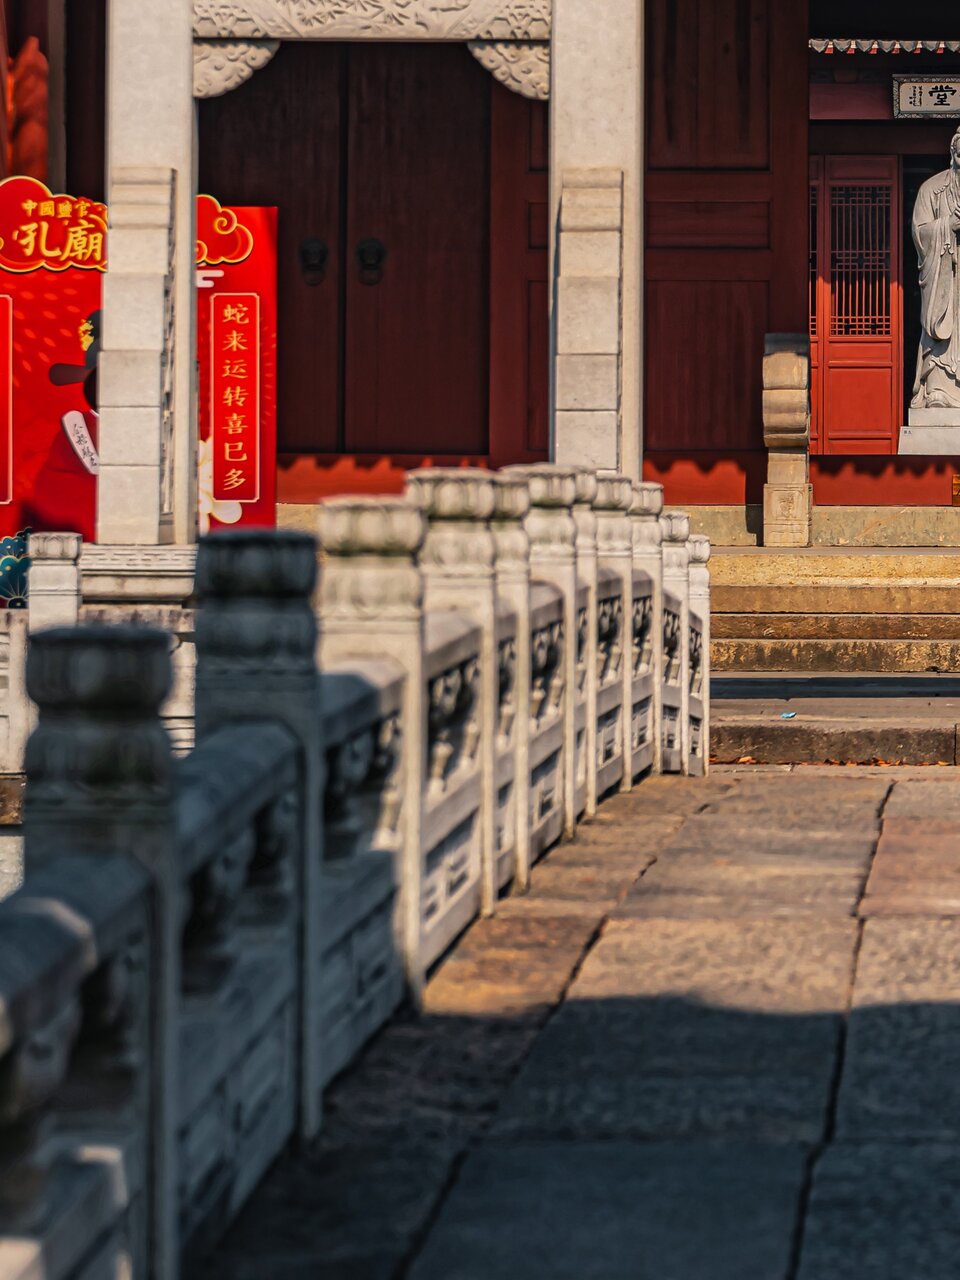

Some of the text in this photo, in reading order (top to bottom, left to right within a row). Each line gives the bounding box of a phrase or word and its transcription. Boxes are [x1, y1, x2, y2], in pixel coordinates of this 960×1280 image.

[14, 219, 104, 263] 孔廟
[222, 303, 250, 491] 蛇来运转喜巳多
